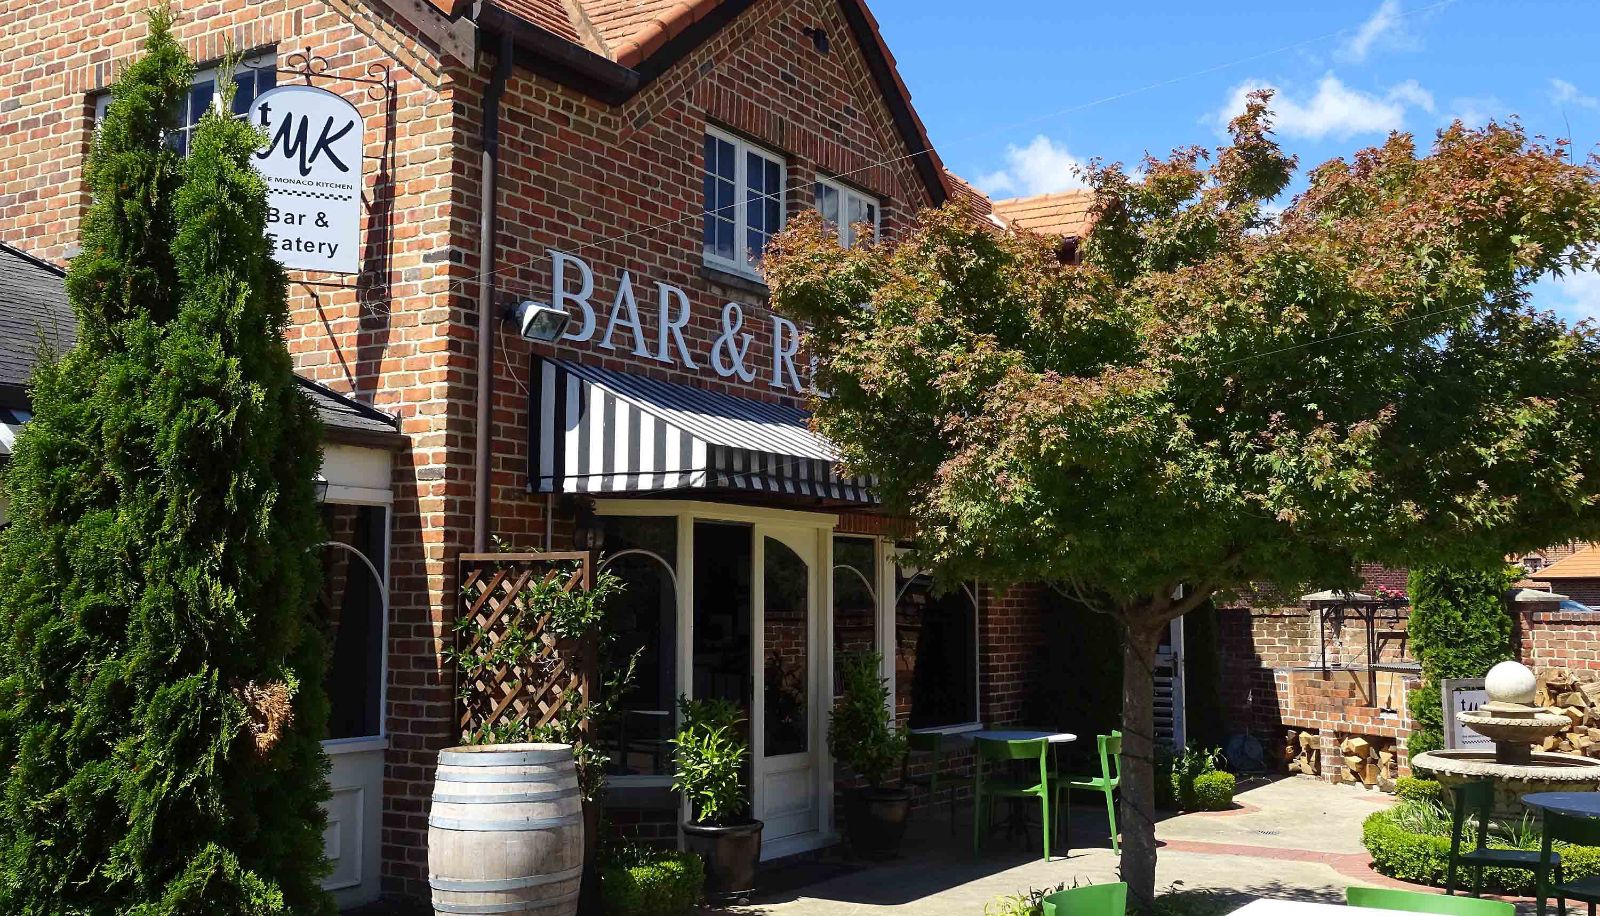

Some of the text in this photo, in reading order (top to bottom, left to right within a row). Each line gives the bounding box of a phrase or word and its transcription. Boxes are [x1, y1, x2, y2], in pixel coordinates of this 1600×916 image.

[274, 177, 314, 186] MONACO
[316, 181, 353, 190] KITCHEN
[266, 207, 329, 228] Bar &
[548, 249, 699, 369] BAR
[710, 302, 757, 382] &
